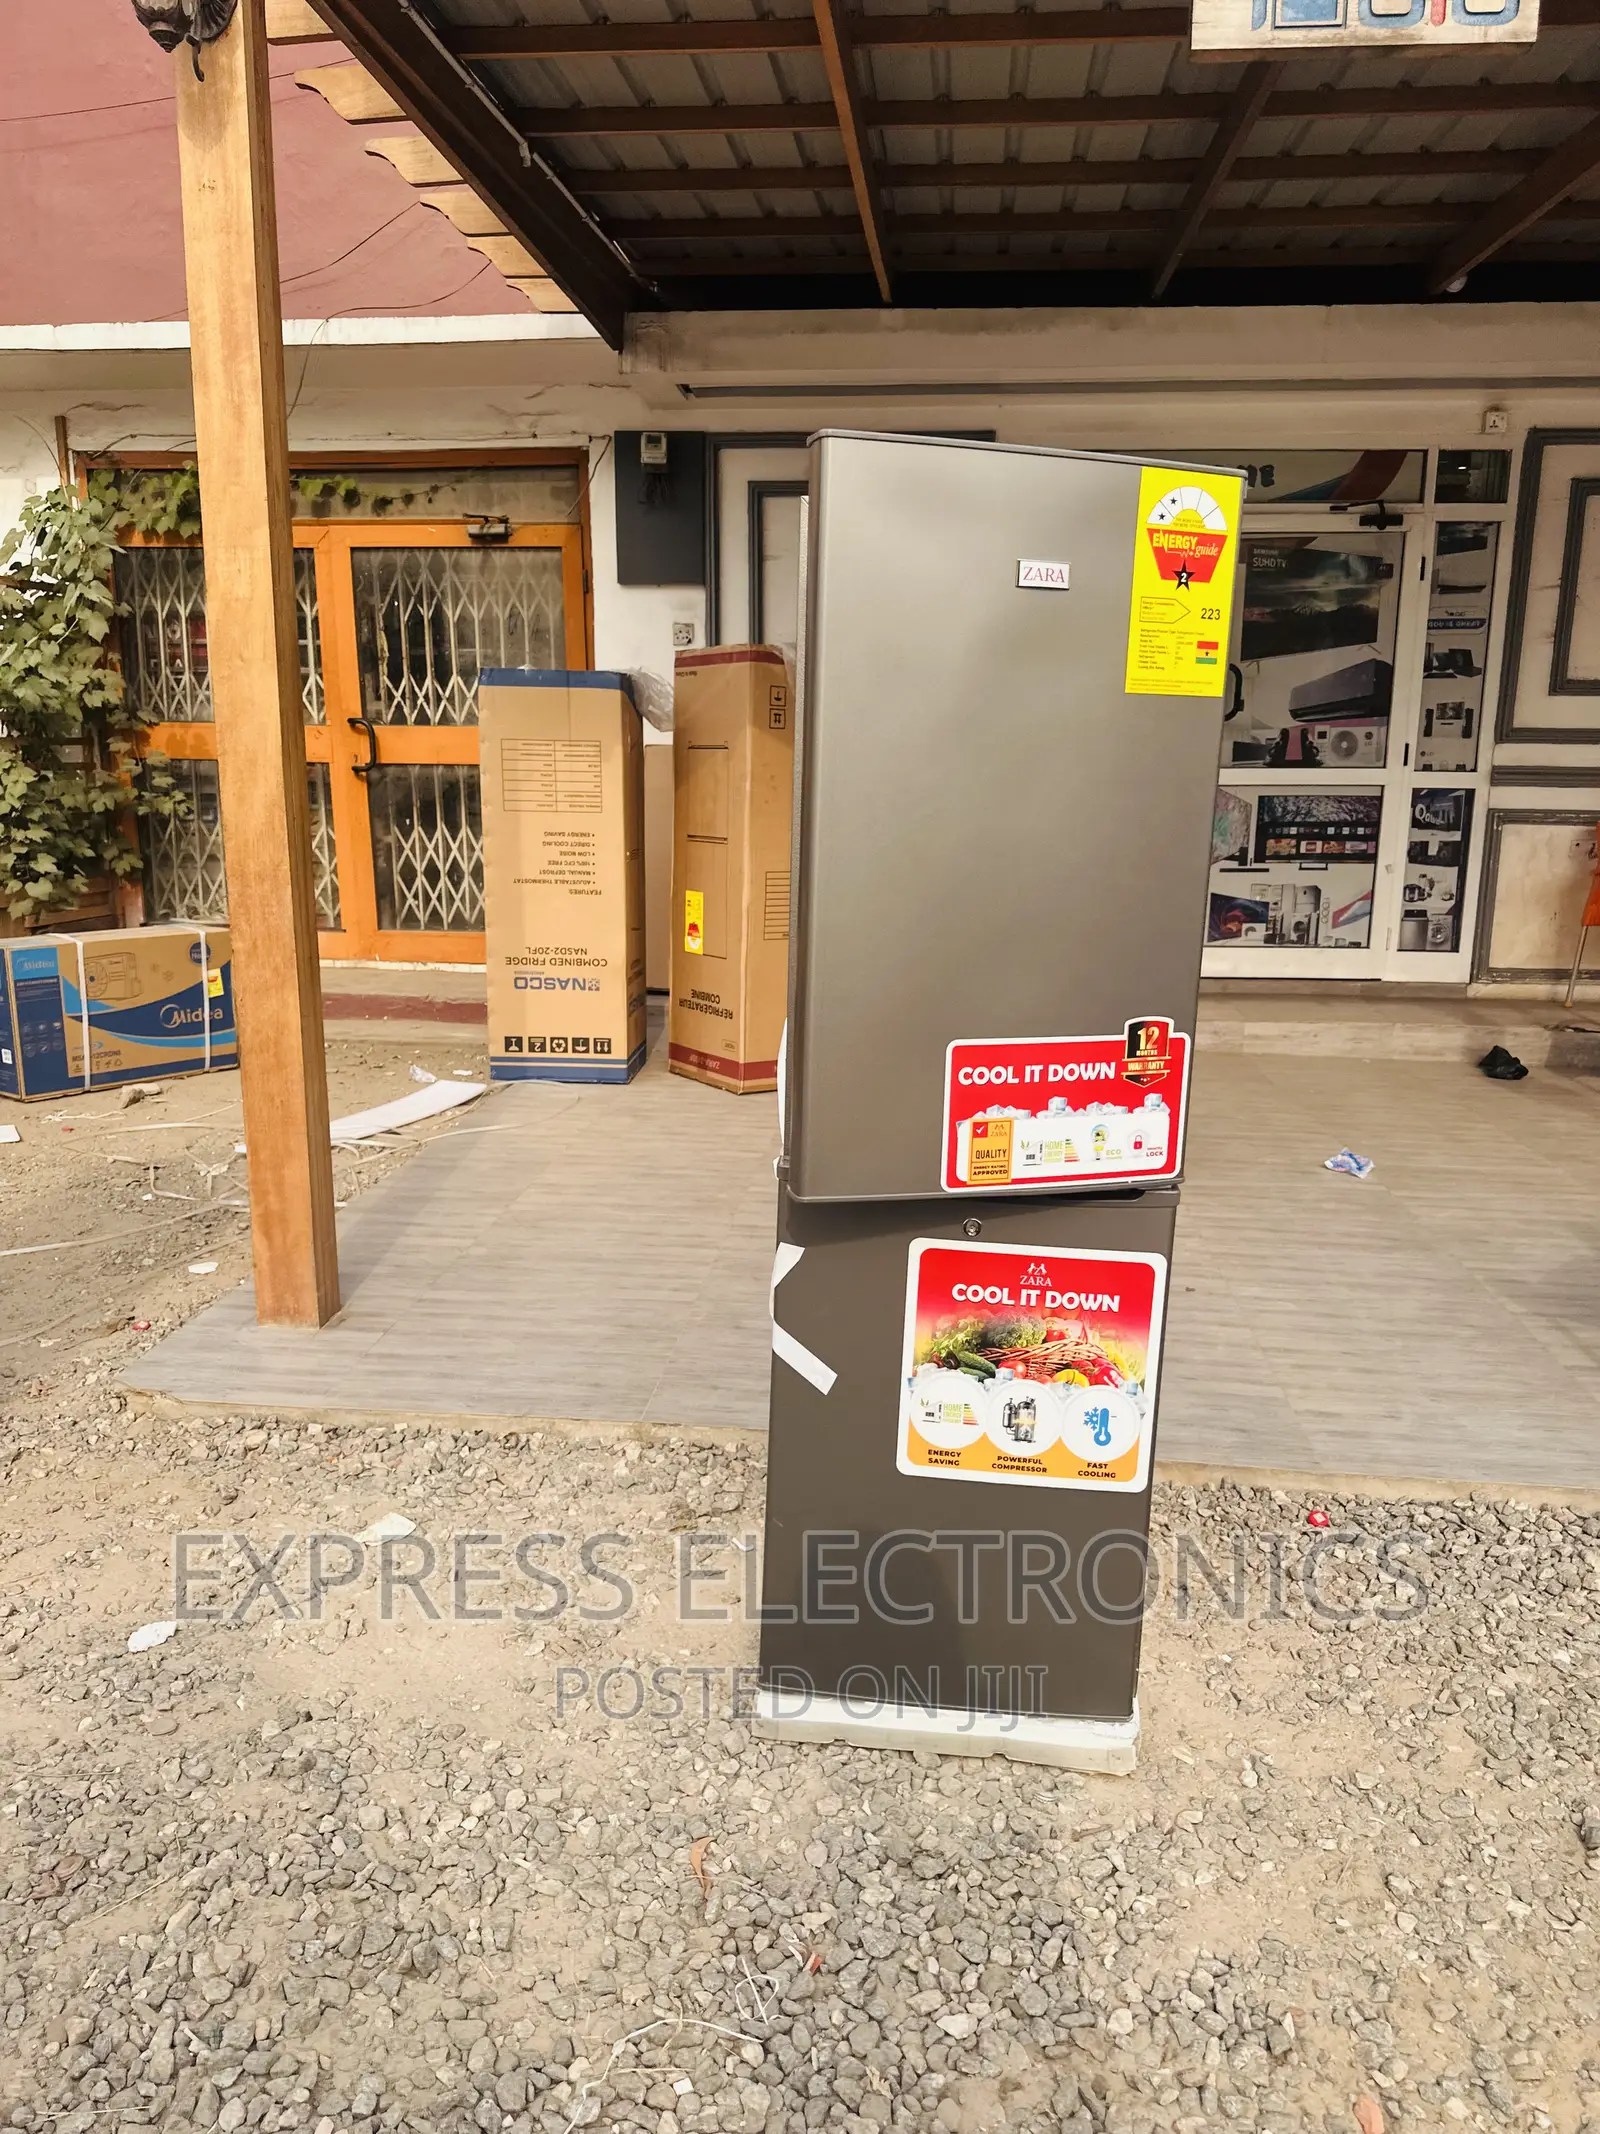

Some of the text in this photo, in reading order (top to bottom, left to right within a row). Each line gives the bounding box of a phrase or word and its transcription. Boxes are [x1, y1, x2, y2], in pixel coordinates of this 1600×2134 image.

[1152, 529, 1198, 552] ENERGY
[1194, 543, 1219, 558] guide
[1022, 566, 1066, 583] ZARA
[1180, 572, 1187, 583] 2
[1200, 608, 1221, 620] 223
[525, 947, 587, 955] NASD2-20FL
[505, 957, 608, 967] COMBINED FRIDGE
[513, 977, 587, 991] NASCO
[690, 989, 721, 1004] COMBINE
[678, 998, 734, 1020] RÉFRIGÉRATEUR
[1137, 1026, 1160, 1050] 12
[1128, 1061, 1165, 1071] WARRANTY
[957, 1061, 1117, 1086] COOL IT DOWN
[1045, 1140, 1064, 1150] HOME
[975, 1149, 1007, 1159] QUALITY
[1020, 1275, 1053, 1287] ZARA
[951, 1283, 1120, 1312] COOL IT DOWN
[943, 1403, 962, 1412] HOME
[927, 1449, 962, 1458] ENERGY
[928, 1457, 960, 1466] SAVING
[997, 1455, 1043, 1465] POWERFUL
[991, 1463, 1048, 1474] COMPRESSOR
[1087, 1462, 1109, 1470] FAST
[1077, 1469, 1117, 1479] COOLING
